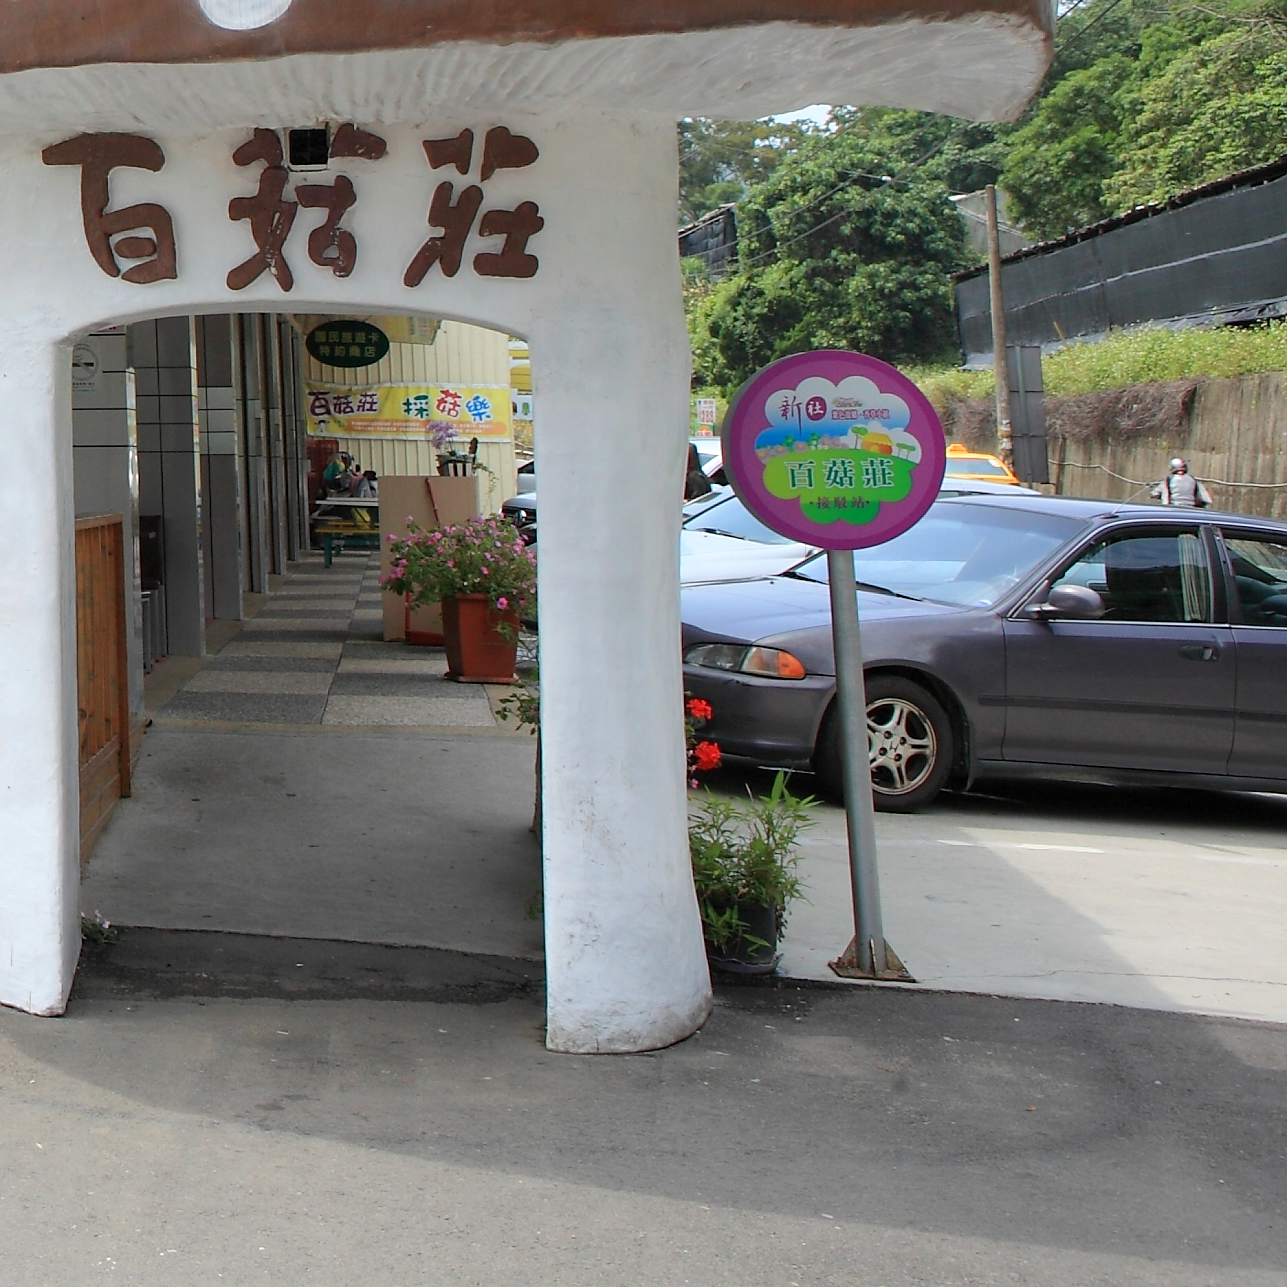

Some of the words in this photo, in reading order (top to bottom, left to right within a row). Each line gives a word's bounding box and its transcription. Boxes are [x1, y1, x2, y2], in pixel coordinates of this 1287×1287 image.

[41, 123, 545, 292] 百菇莊
[307, 391, 378, 417] 百菇莊
[784, 458, 895, 489] 百菇莊
